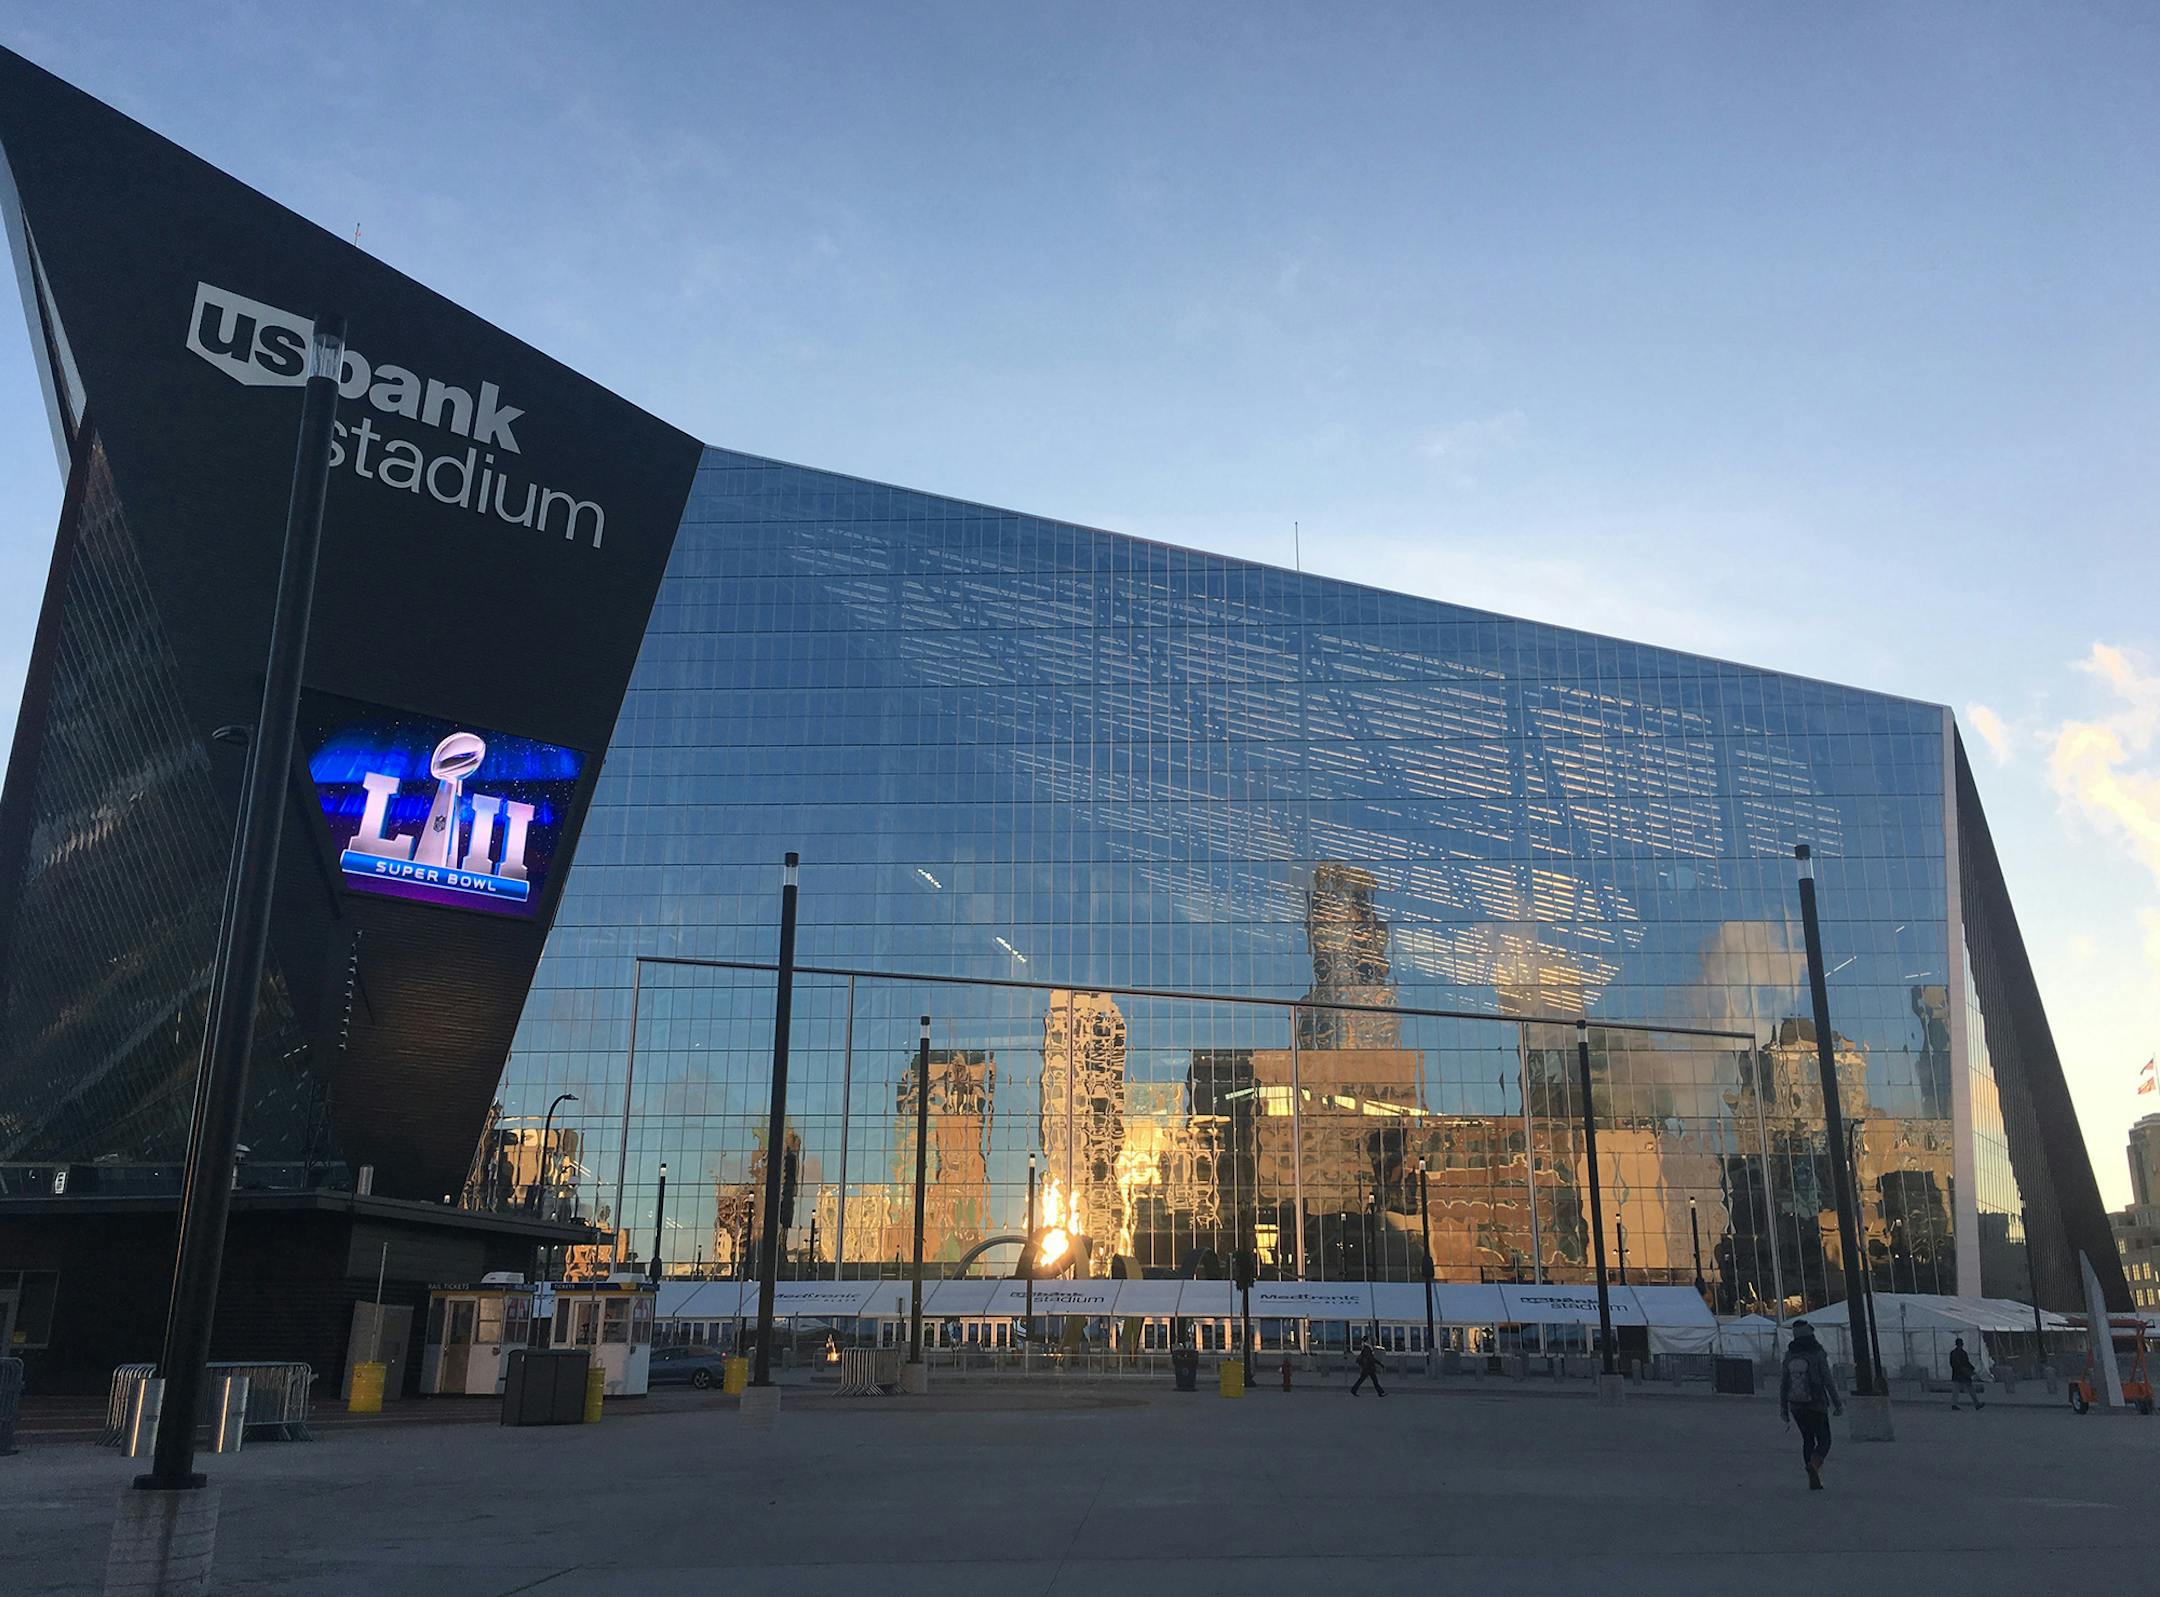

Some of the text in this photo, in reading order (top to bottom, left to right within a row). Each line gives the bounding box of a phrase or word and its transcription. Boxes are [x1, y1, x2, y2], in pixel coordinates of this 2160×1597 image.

[197, 302, 306, 378] us
[375, 860, 497, 893] SUPER BOWL
[1551, 1302, 1628, 1311] stadim
